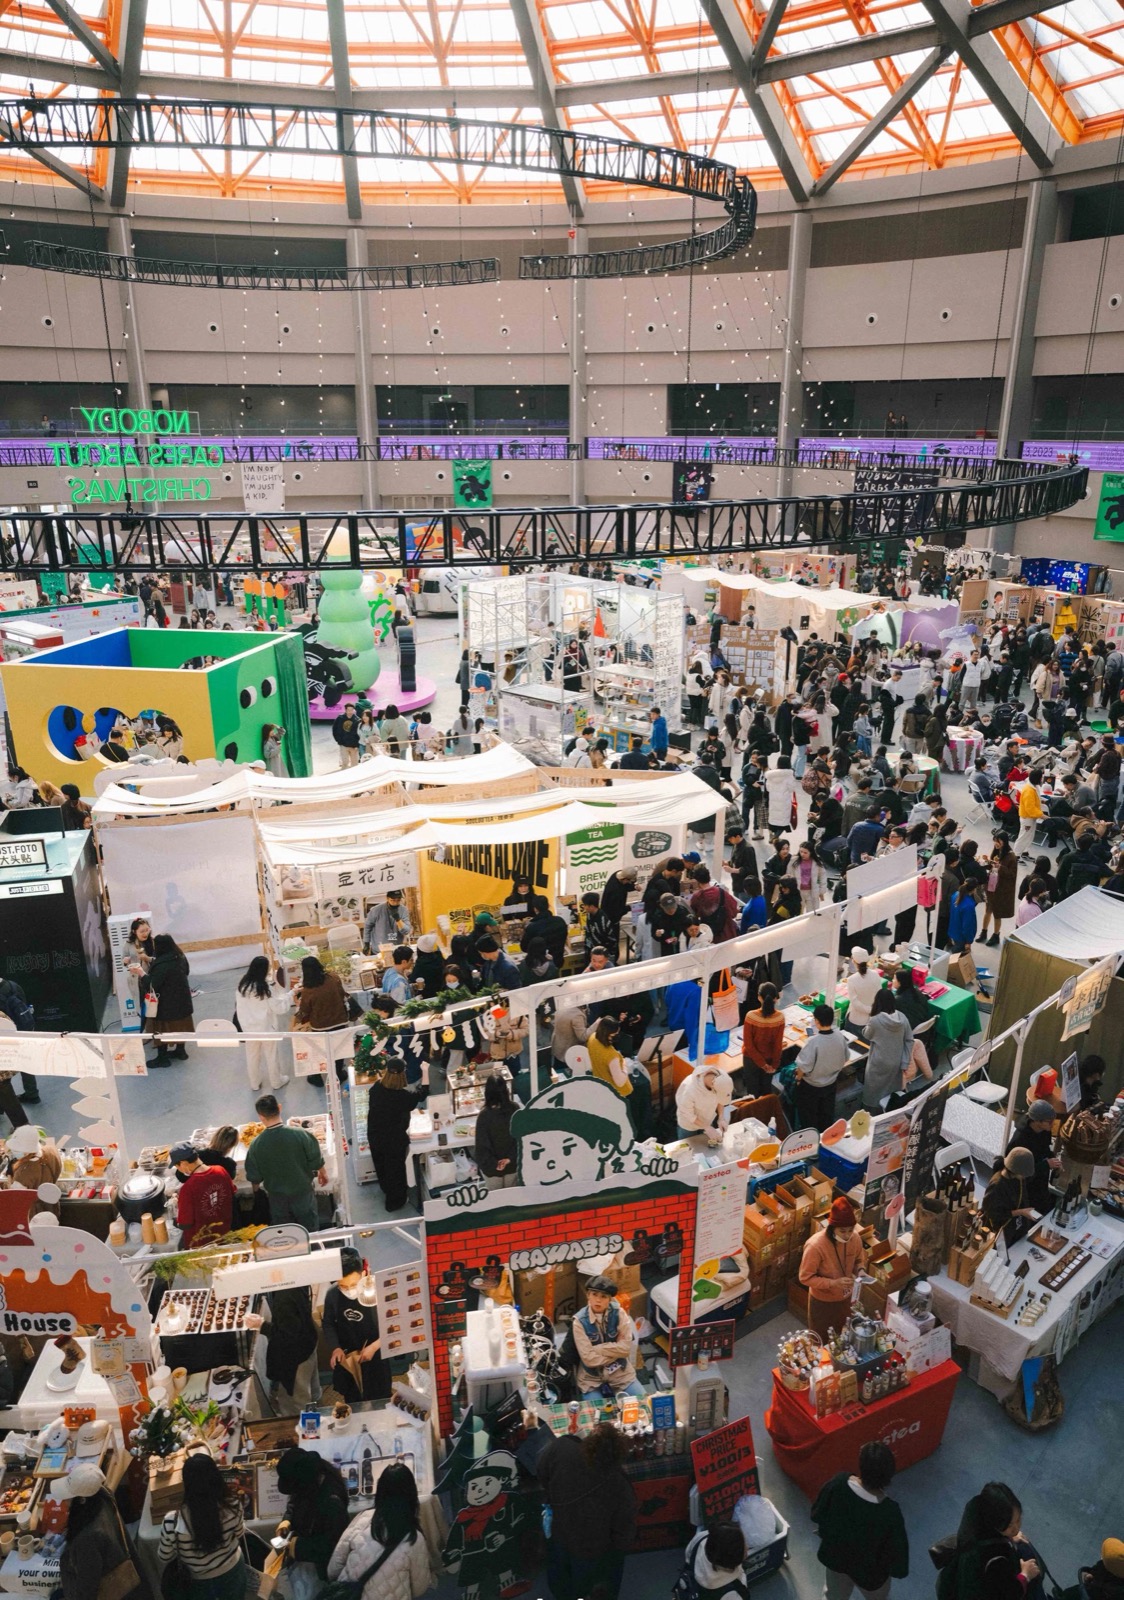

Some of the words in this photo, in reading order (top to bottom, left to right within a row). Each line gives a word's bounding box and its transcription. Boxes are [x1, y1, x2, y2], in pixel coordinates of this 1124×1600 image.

[587, 831, 604, 839] TEA
[0, 844, 38, 856] ST.FOTO
[338, 864, 395, 888] 豆花店
[580, 871, 608, 883] BREW
[4, 1313, 72, 1332] House
[695, 1421, 748, 1455] CHRISTMAS
[709, 1438, 737, 1460] PRICE
[43, 1559, 60, 1567] Min
[18, 1569, 40, 1578] your
